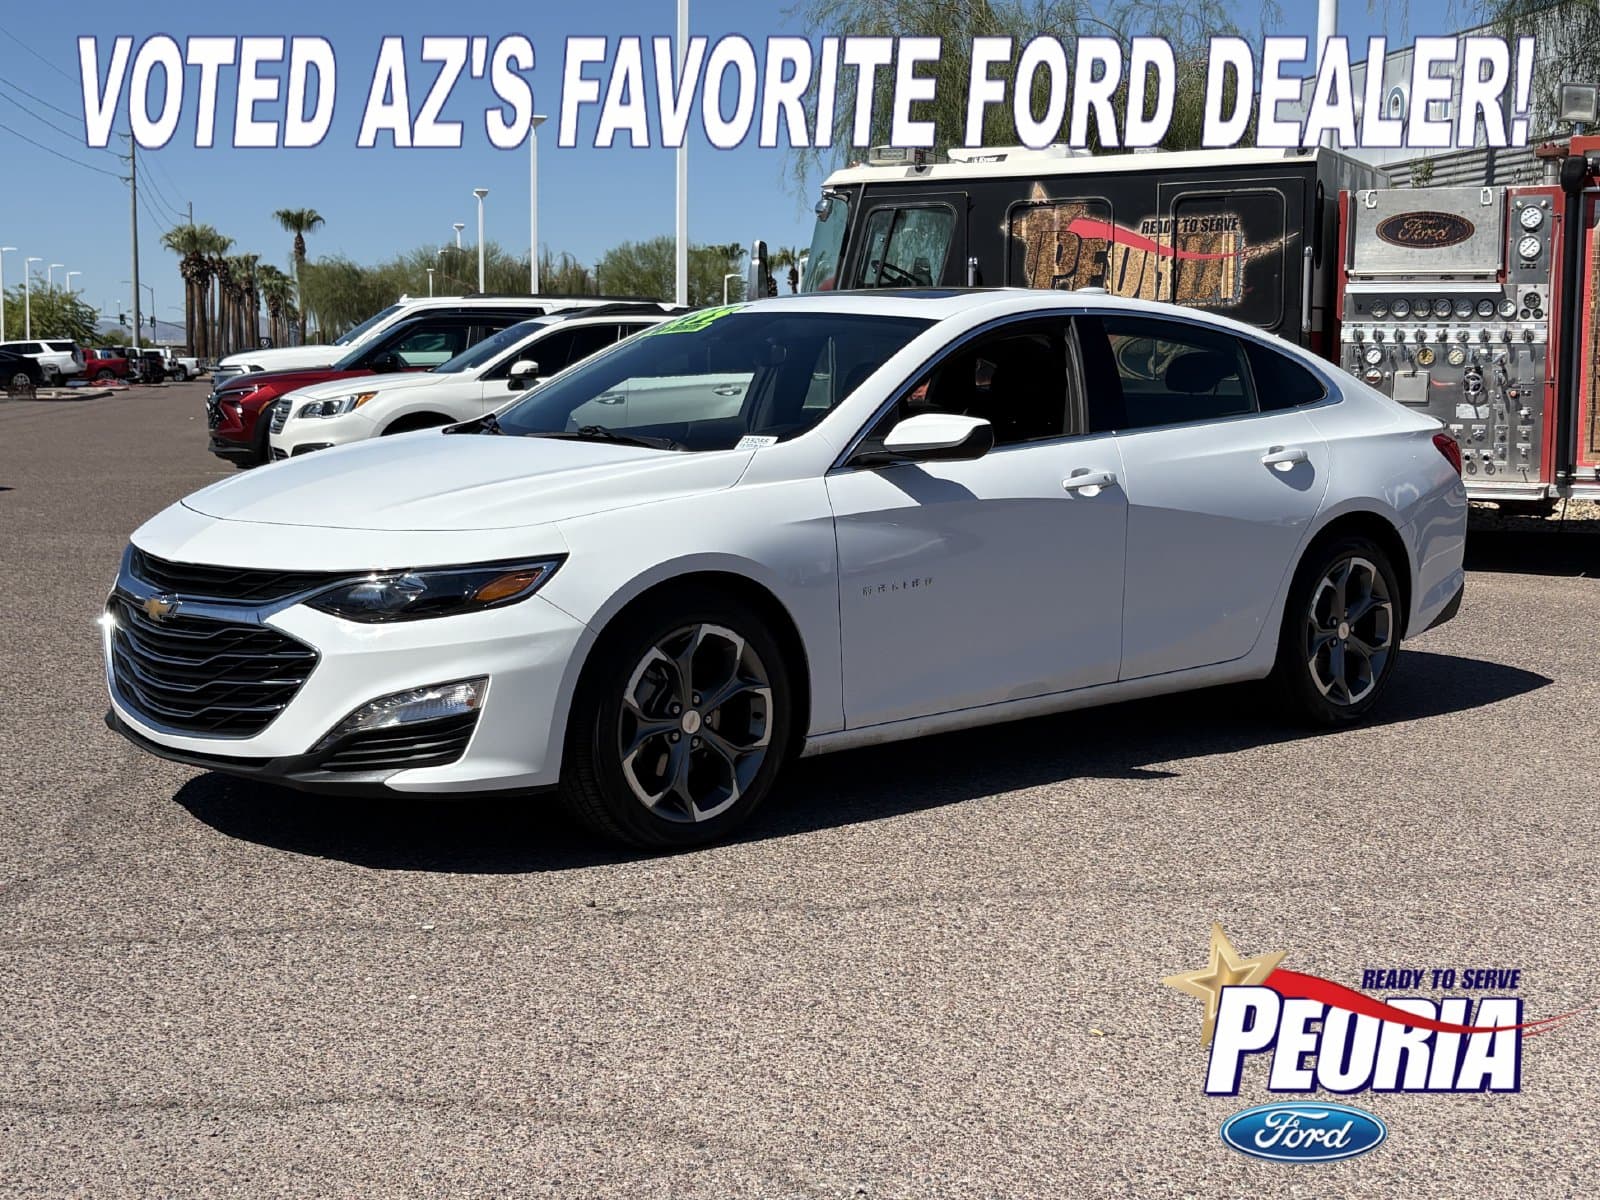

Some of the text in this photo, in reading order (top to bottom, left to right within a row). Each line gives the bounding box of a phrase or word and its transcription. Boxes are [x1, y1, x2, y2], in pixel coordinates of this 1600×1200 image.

[1141, 217, 1239, 234] READ TO SERVE
[1400, 218, 1449, 241] Ford
